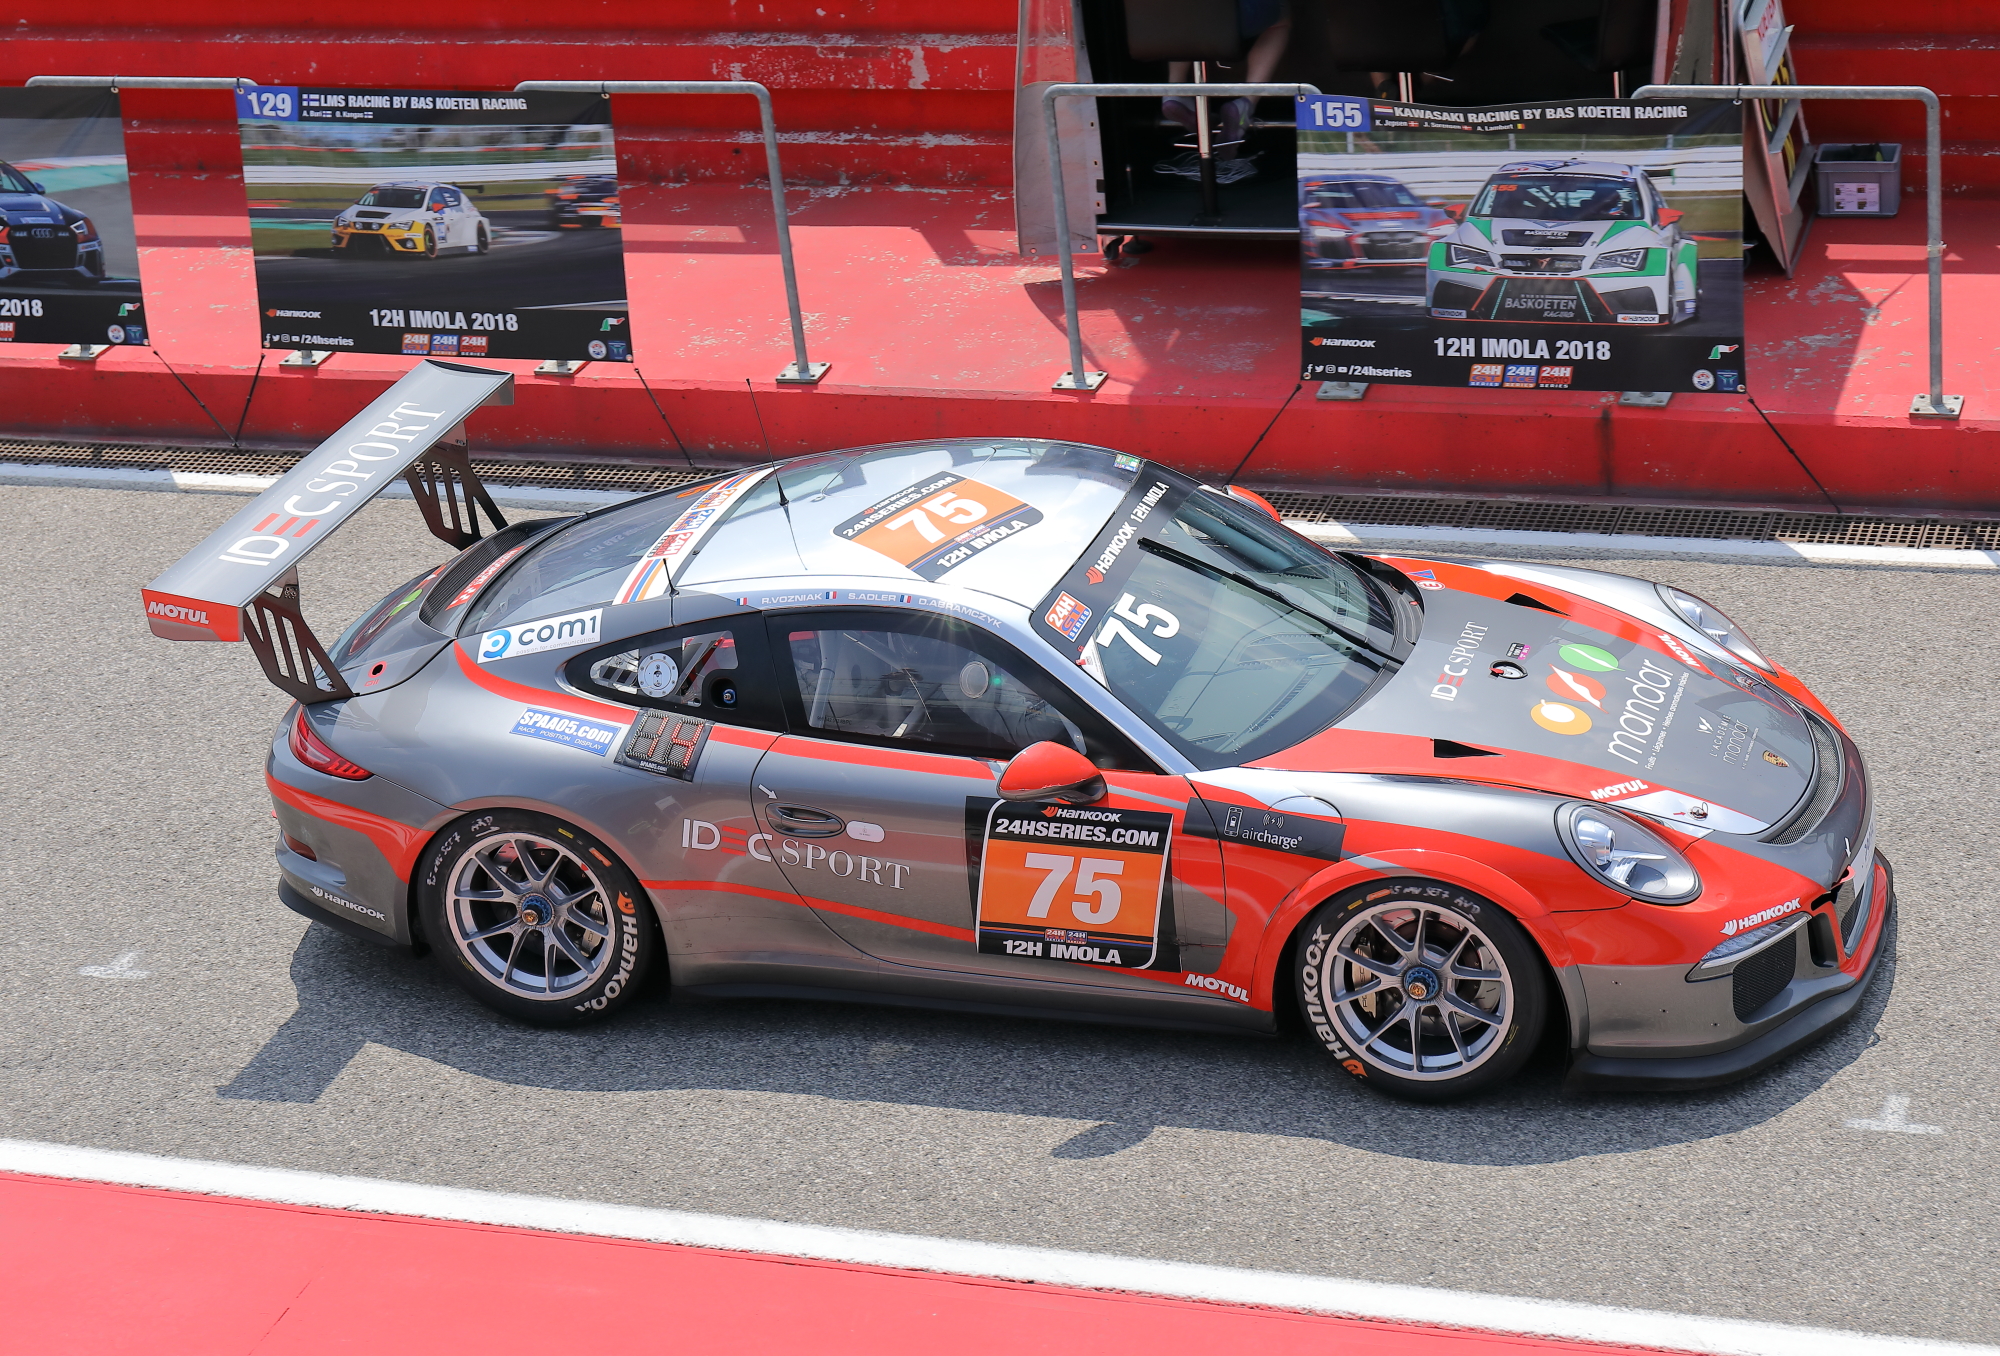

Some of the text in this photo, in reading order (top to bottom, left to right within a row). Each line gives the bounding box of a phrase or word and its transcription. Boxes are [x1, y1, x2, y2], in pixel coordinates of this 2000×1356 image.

[247, 92, 292, 118] 129
[320, 94, 528, 110] LMS RACING BY BAS KOETEN RACING
[1310, 101, 1363, 127] 155
[1393, 105, 1688, 123] KAWASAKI RACING BY BAS KOETEN RACING
[1384, 120, 1408, 128] Jepsen
[1484, 123, 1513, 131] Lambert
[1491, 184, 1519, 192] 155
[0, 299, 43, 317] 2018
[1504, 298, 1577, 310] BASKOETEN
[369, 308, 519, 331] 12H IMOLA 2018
[300, 334, 355, 347] /24hseries
[403, 334, 428, 344] 24H
[432, 335, 458, 345] 24H
[461, 336, 487, 346] 24H
[1434, 337, 1611, 360] 12H IMOLA 2018
[1348, 365, 1412, 378] /24hseries
[1472, 365, 1501, 375] 24H
[1506, 366, 1537, 376] 24H
[1541, 367, 1571, 377] 24H
[218, 401, 446, 566] IDEC SPORT
[707, 490, 734, 507] 24H
[842, 476, 957, 537] 24HSERIES.COM
[1130, 503, 1152, 523] 12H
[1144, 481, 1170, 508] IMOLA
[685, 508, 714, 530] 24H
[884, 491, 988, 544] 75
[661, 532, 693, 555] 24H
[936, 546, 974, 568] 12H
[969, 519, 1029, 550] IMOLA
[761, 593, 822, 605] R.VOZNIAK
[848, 592, 896, 602] S.ADLER
[148, 601, 209, 625] MOTUL
[918, 598, 1002, 628] D.ABRAMCZYK
[1049, 595, 1076, 628] 24H
[1061, 603, 1085, 632] GT
[1068, 608, 1091, 639] SERIES
[518, 615, 597, 646] com1
[1096, 592, 1181, 667] 75
[515, 647, 539, 655] passion
[549, 636, 596, 649] communication
[1658, 634, 1701, 667] MOTUL
[1430, 621, 1488, 702] IDEC SPORT
[1607, 658, 1674, 765] mandar
[517, 726, 603, 750] RACE POSITION DISPLAY
[519, 710, 614, 745] SPAA05.com
[1644, 756, 1656, 770] Fruits
[1652, 730, 1667, 753] Légumes
[1662, 710, 1675, 728] Herbes
[1723, 719, 1749, 765] mandar
[1590, 779, 1648, 800] MOTUL
[995, 818, 1159, 847] 24HSERIES.COM
[681, 818, 910, 890] IDEC SPORT
[1024, 852, 1125, 925] 75
[1003, 940, 1122, 965] 12H IMOLA
[1185, 973, 1249, 1003] MOTUL
